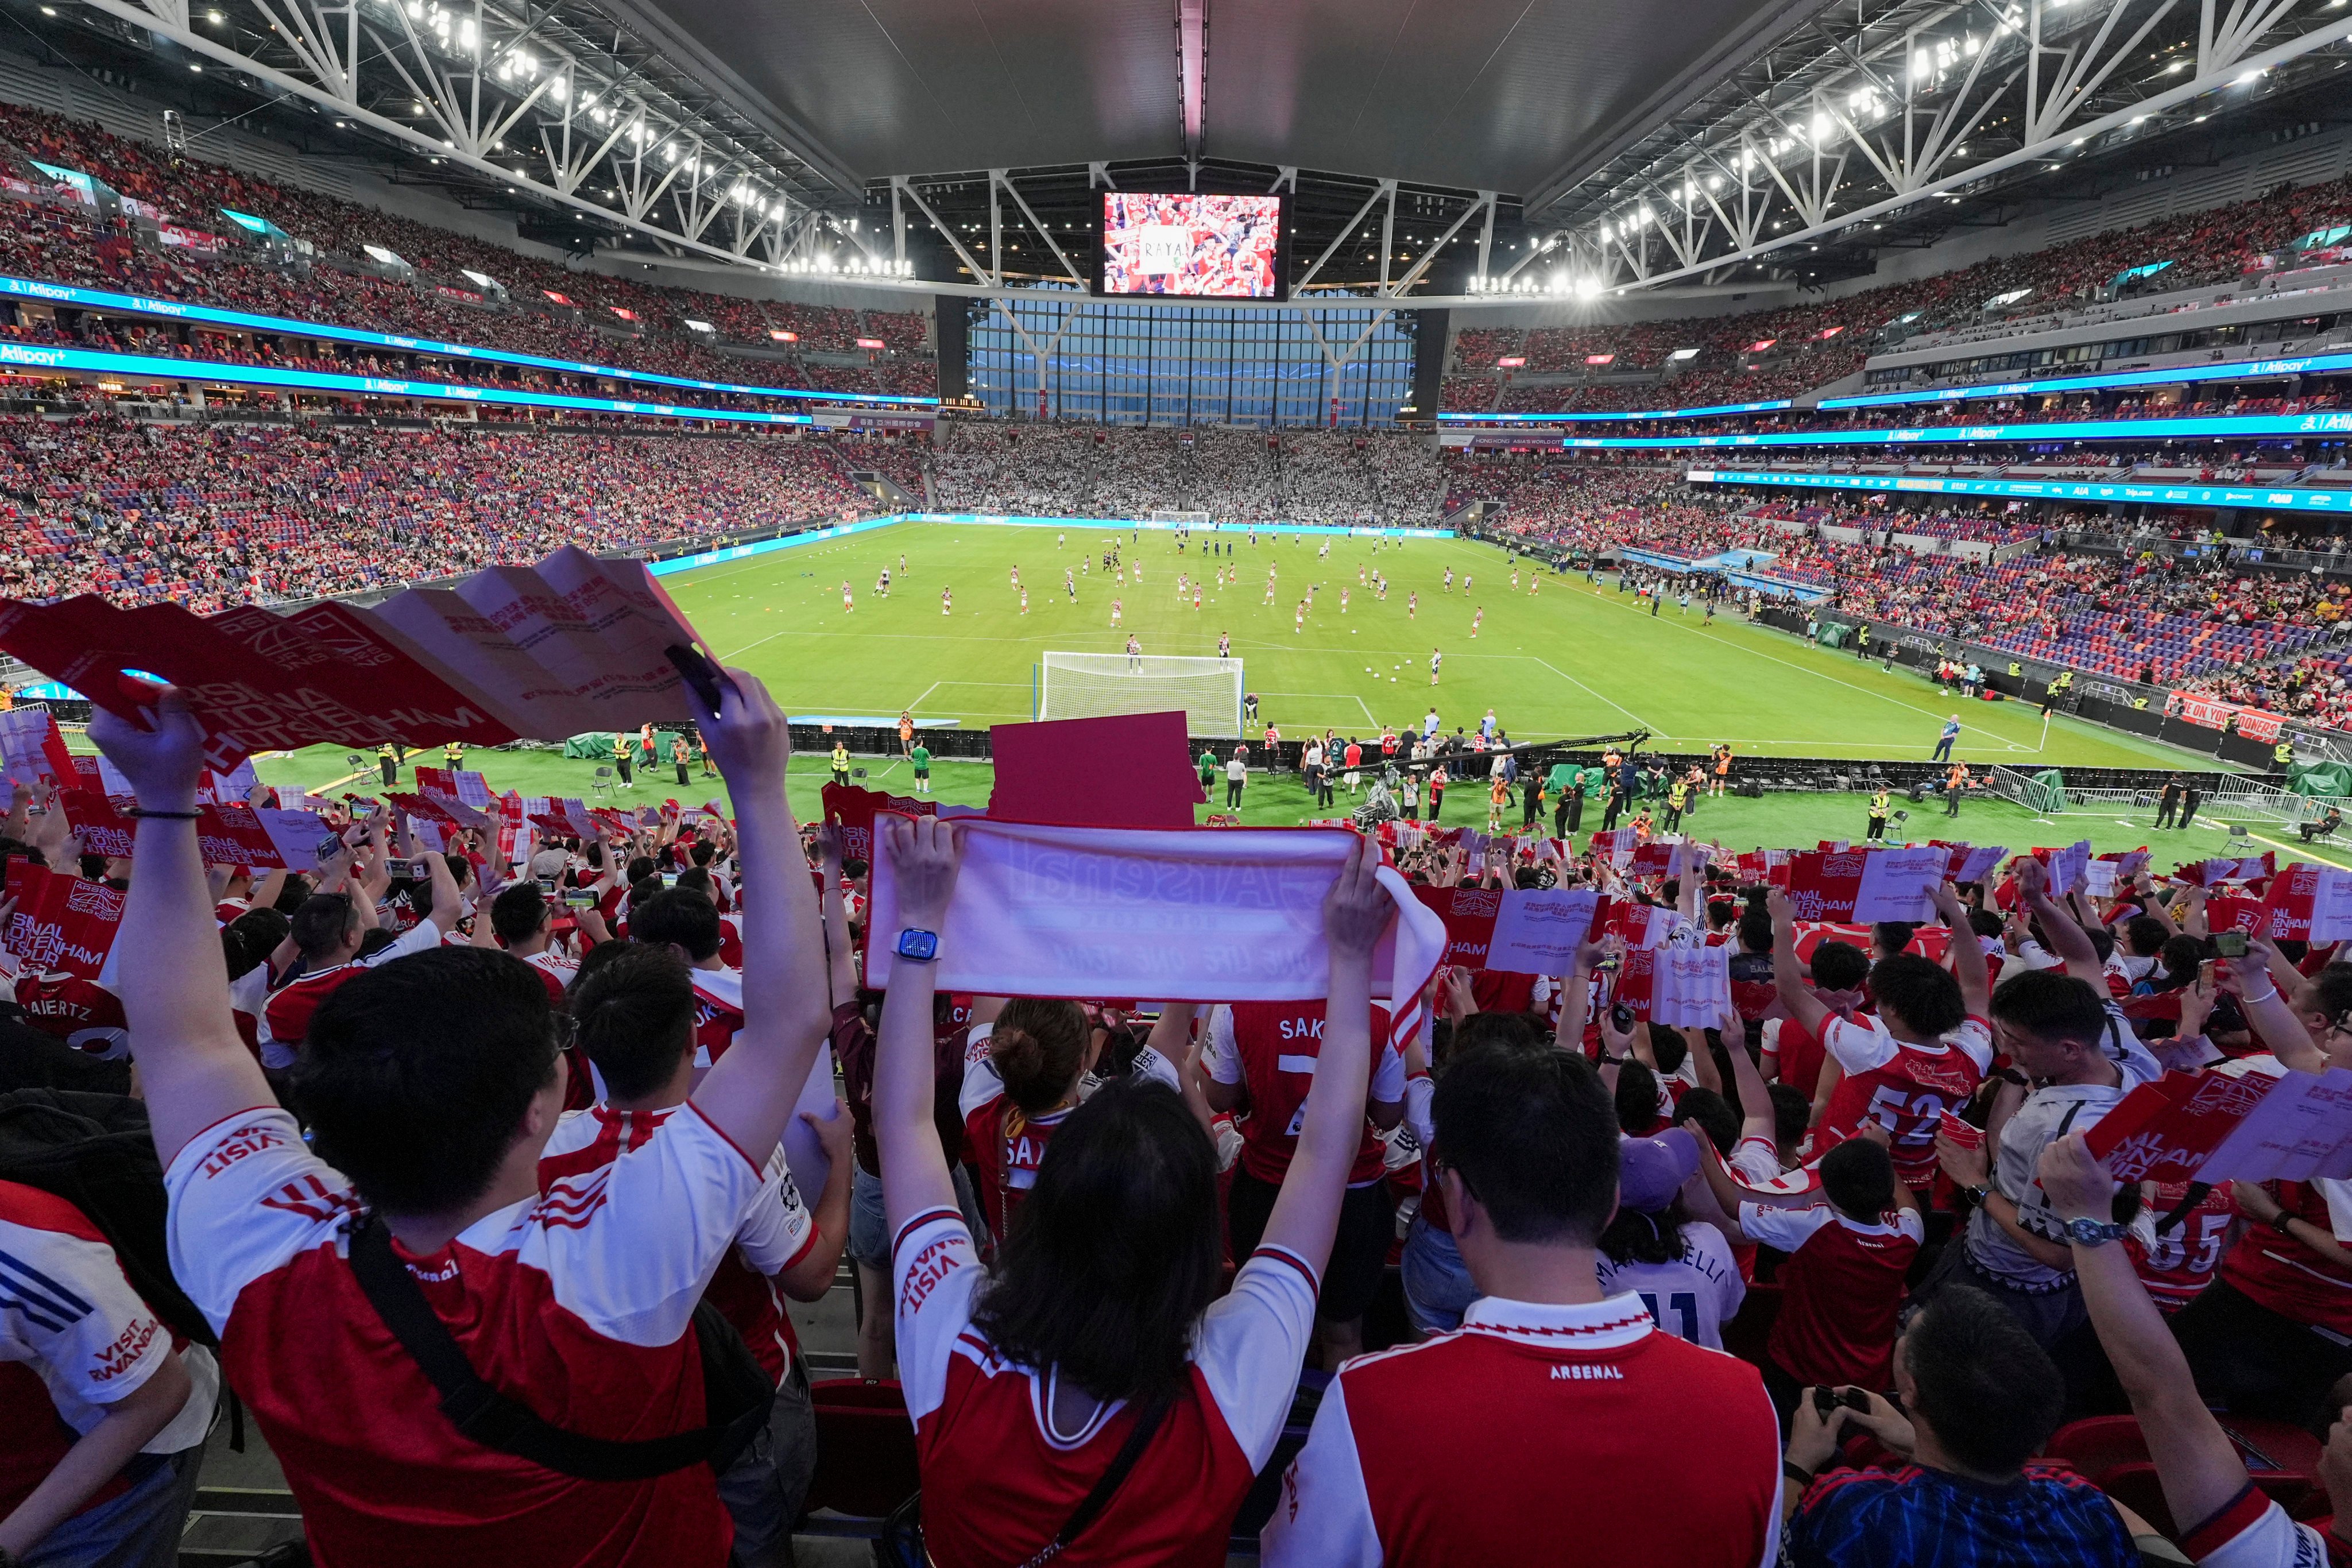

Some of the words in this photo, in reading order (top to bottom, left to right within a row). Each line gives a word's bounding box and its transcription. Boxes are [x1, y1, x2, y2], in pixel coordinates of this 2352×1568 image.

[29, 282, 76, 300] Alipay+
[2265, 358, 2312, 372] Alipay+
[876, 419, 921, 428] 亞洲國際都會
[2072, 486, 2089, 495] AIA
[2126, 488, 2153, 498] Trip.com
[2193, 705, 2206, 718] ON
[890, 800, 930, 811] ARSENAL
[76, 883, 123, 901] ARSENAL
[69, 900, 87, 908] TOUR
[67, 904, 93, 915] HONG
[94, 911, 118, 922] KONG
[203, 1135, 284, 1179] VISIT
[1856, 1238, 1885, 1248] Arsenal
[909, 1255, 960, 1314] VISIT
[94, 1319, 141, 1363] VISIT
[89, 1319, 158, 1383] RWANDA
[1550, 1365, 1624, 1380] ARSENAL
